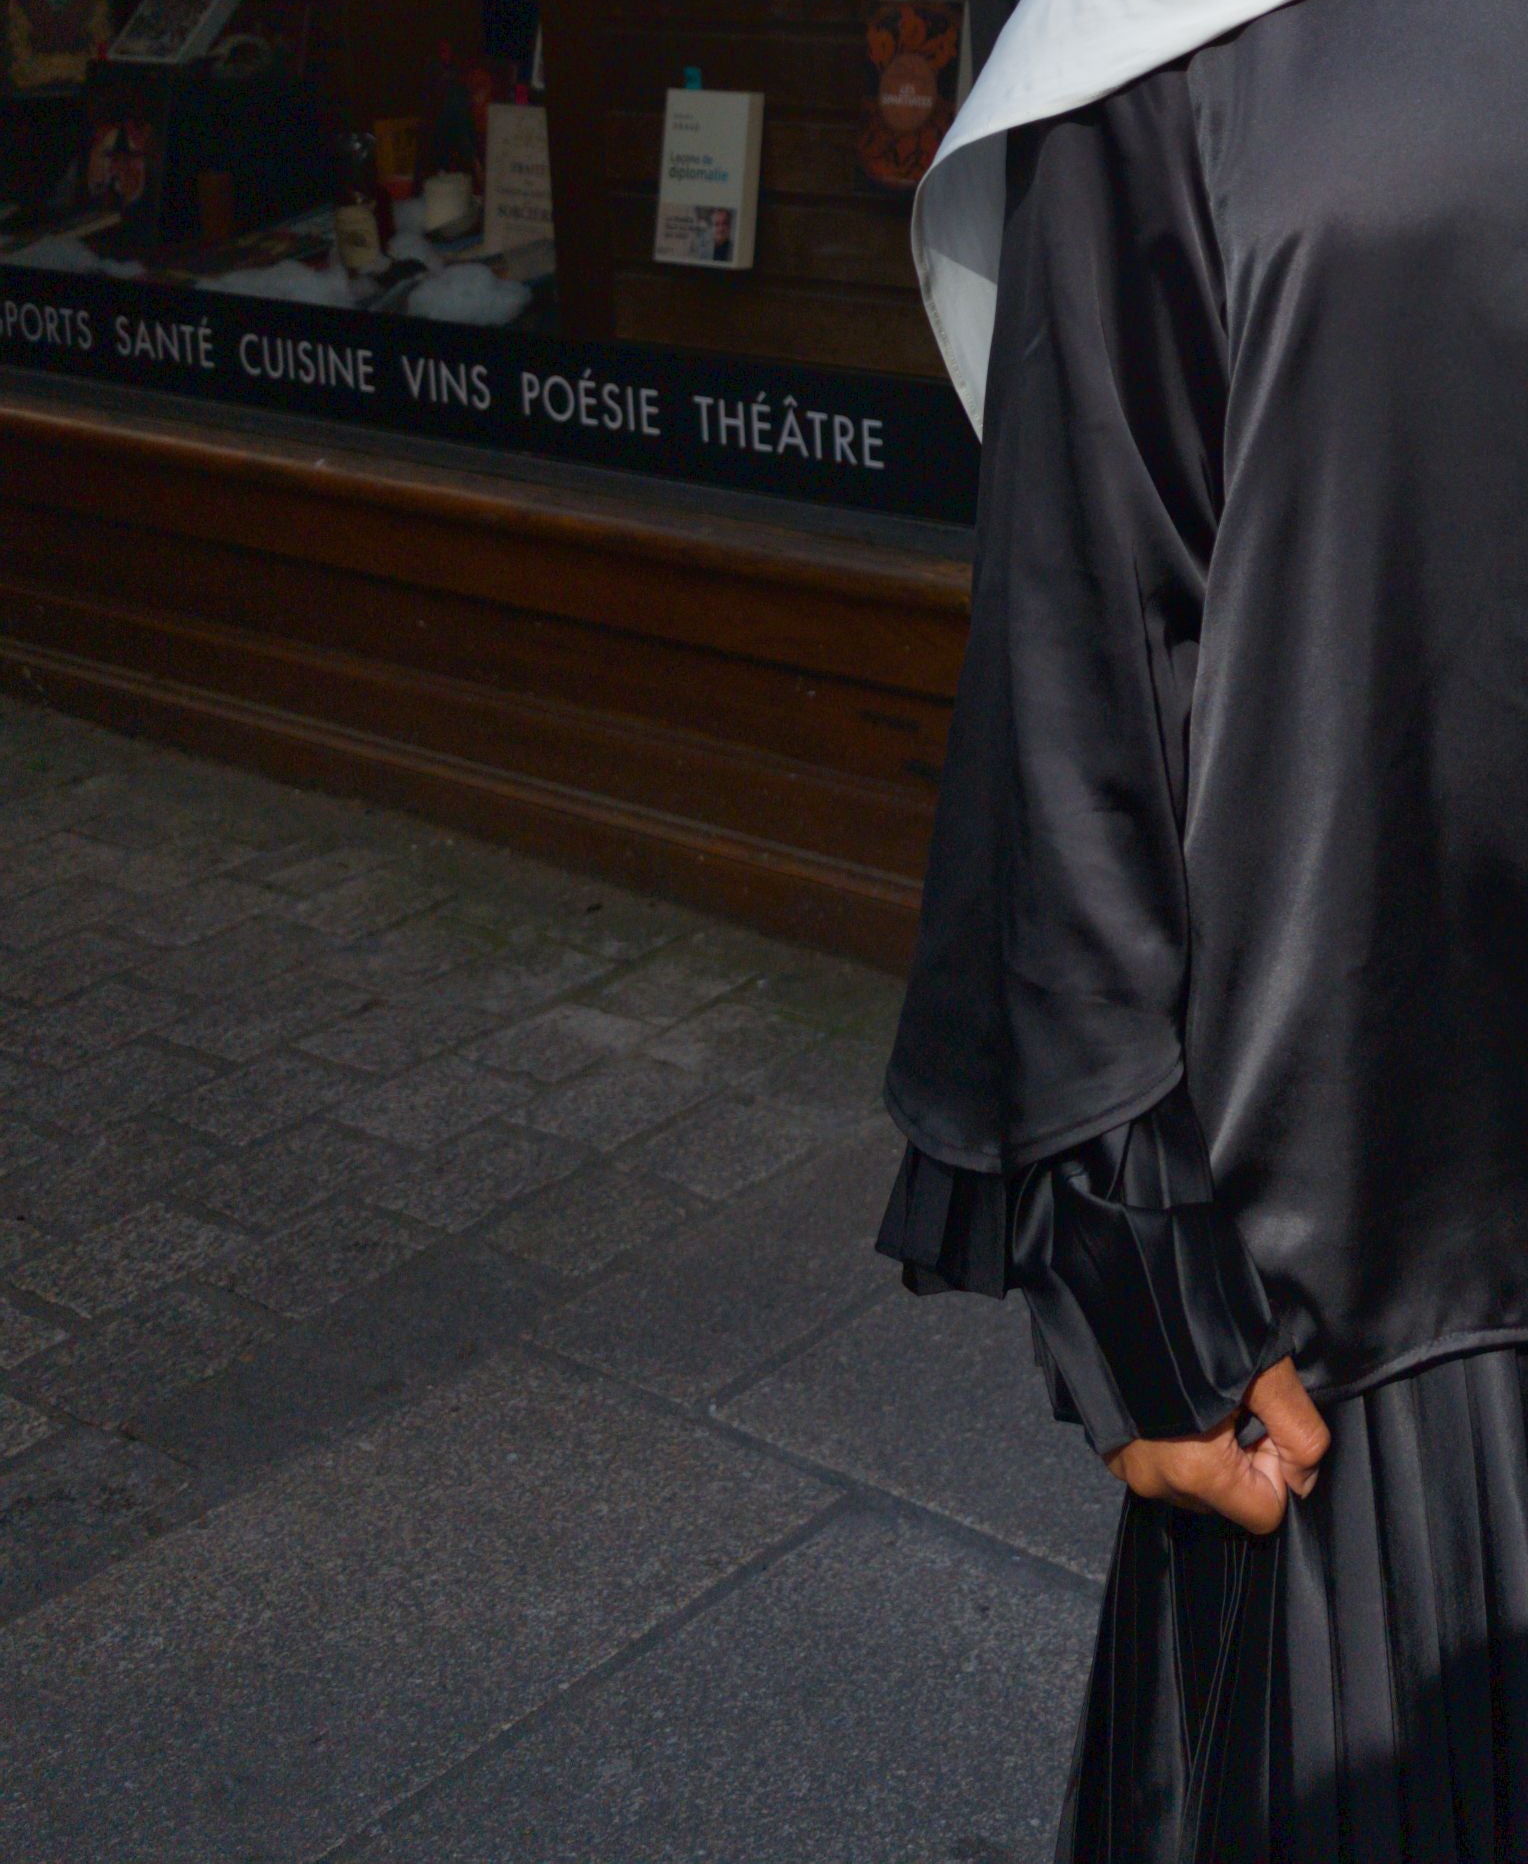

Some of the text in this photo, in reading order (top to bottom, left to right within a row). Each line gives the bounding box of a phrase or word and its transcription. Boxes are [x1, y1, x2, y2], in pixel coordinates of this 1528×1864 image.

[669, 166, 730, 183] diplomatie
[0, 298, 885, 470] PORTS SANTÉ CUISINE VINS POÉSIE THÉÂTRE
